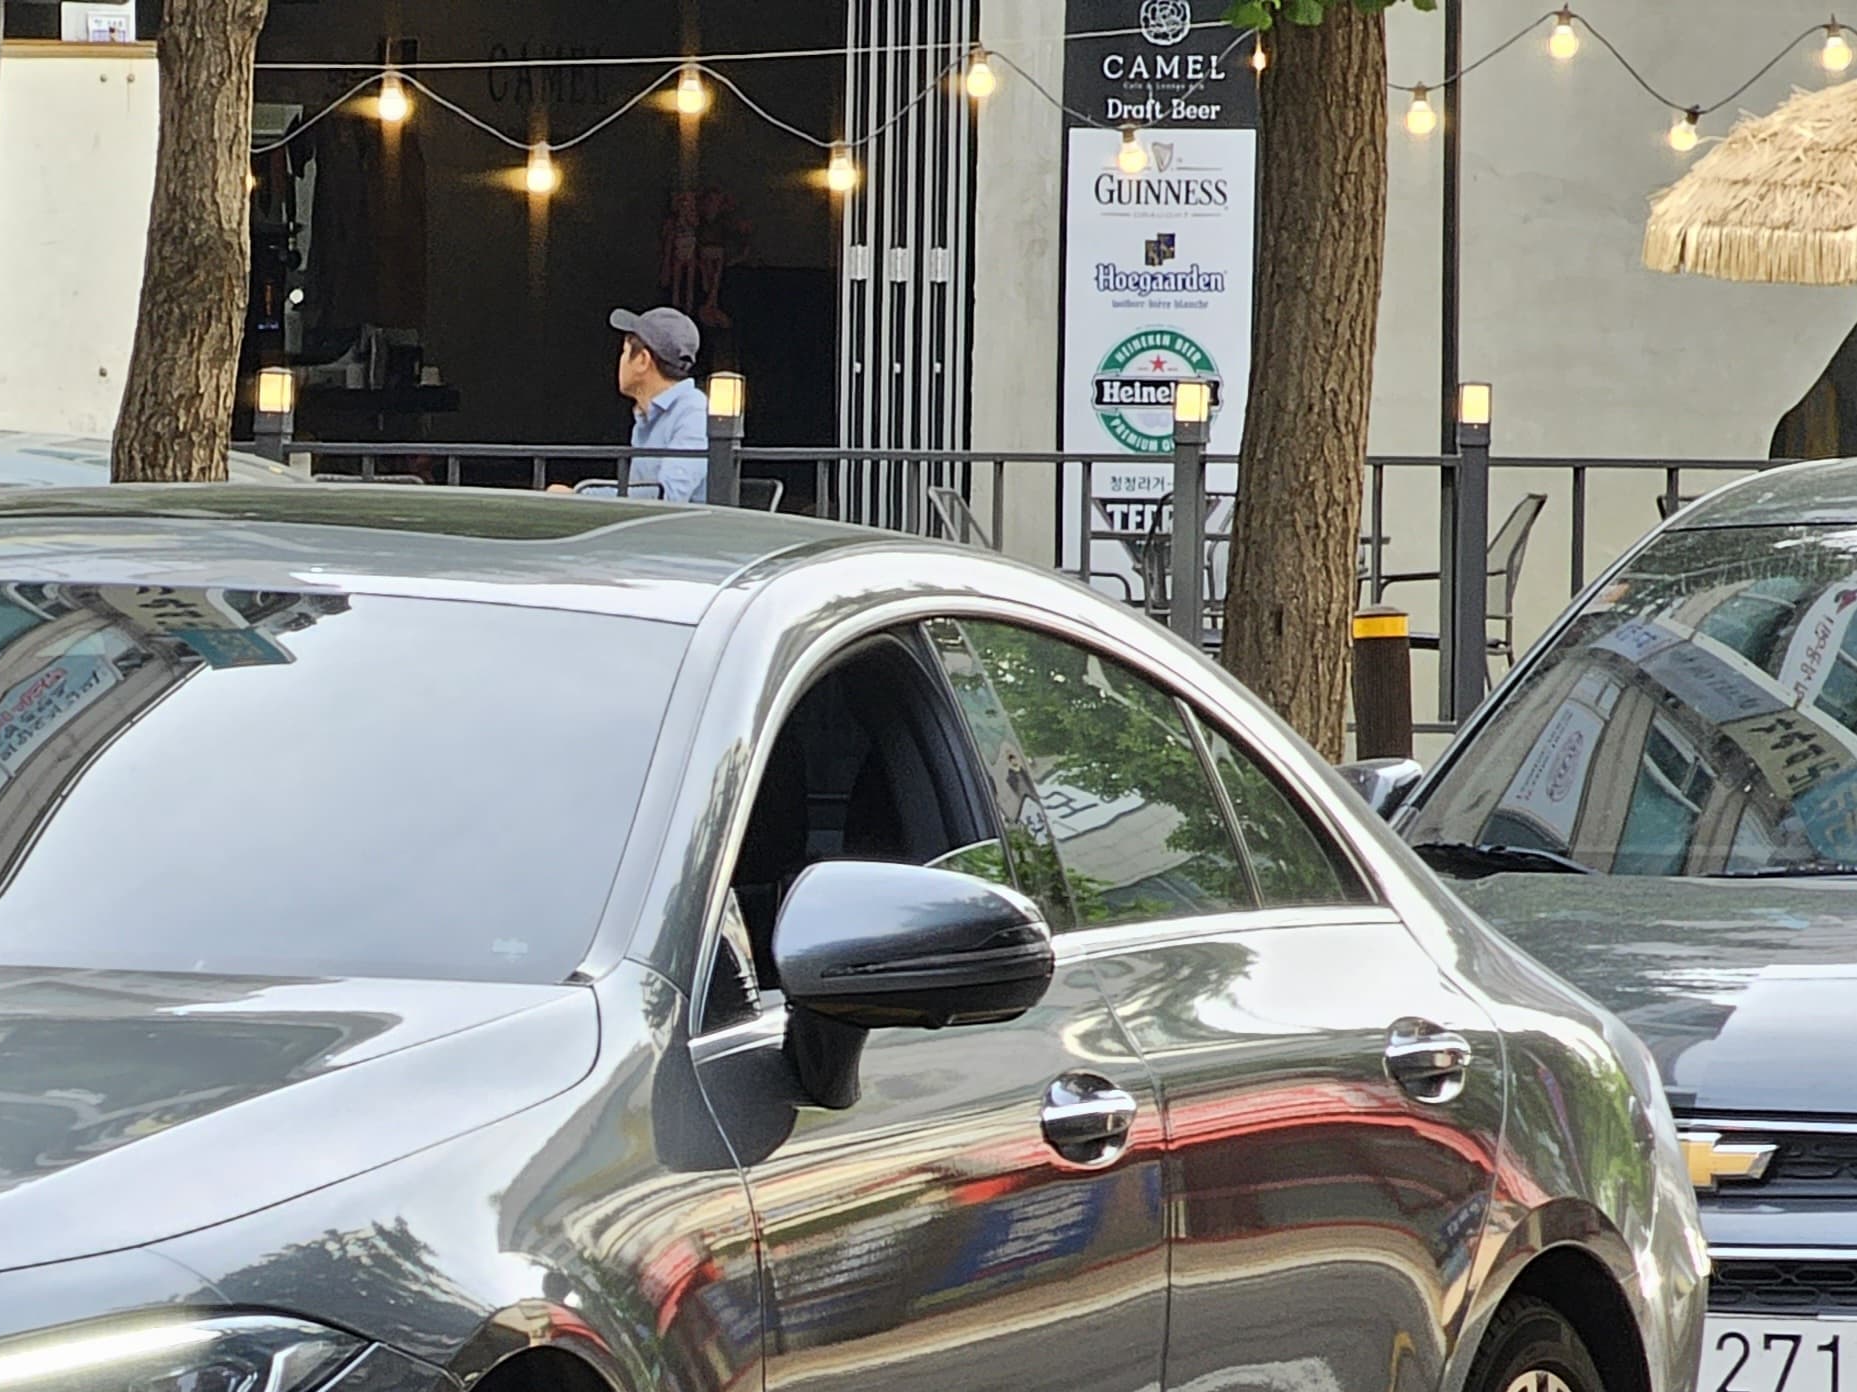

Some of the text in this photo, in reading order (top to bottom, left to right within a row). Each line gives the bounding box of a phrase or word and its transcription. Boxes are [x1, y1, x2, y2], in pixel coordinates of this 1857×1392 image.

[1102, 54, 1226, 80] CAMEL
[1106, 97, 1222, 120] Draft Beer
[1093, 173, 1229, 206] GUINNESS
[1093, 263, 1226, 298] Hoegaarden
[1113, 333, 1204, 364] HEINEKEN BEER
[1109, 418, 1159, 452] PREMIUM
